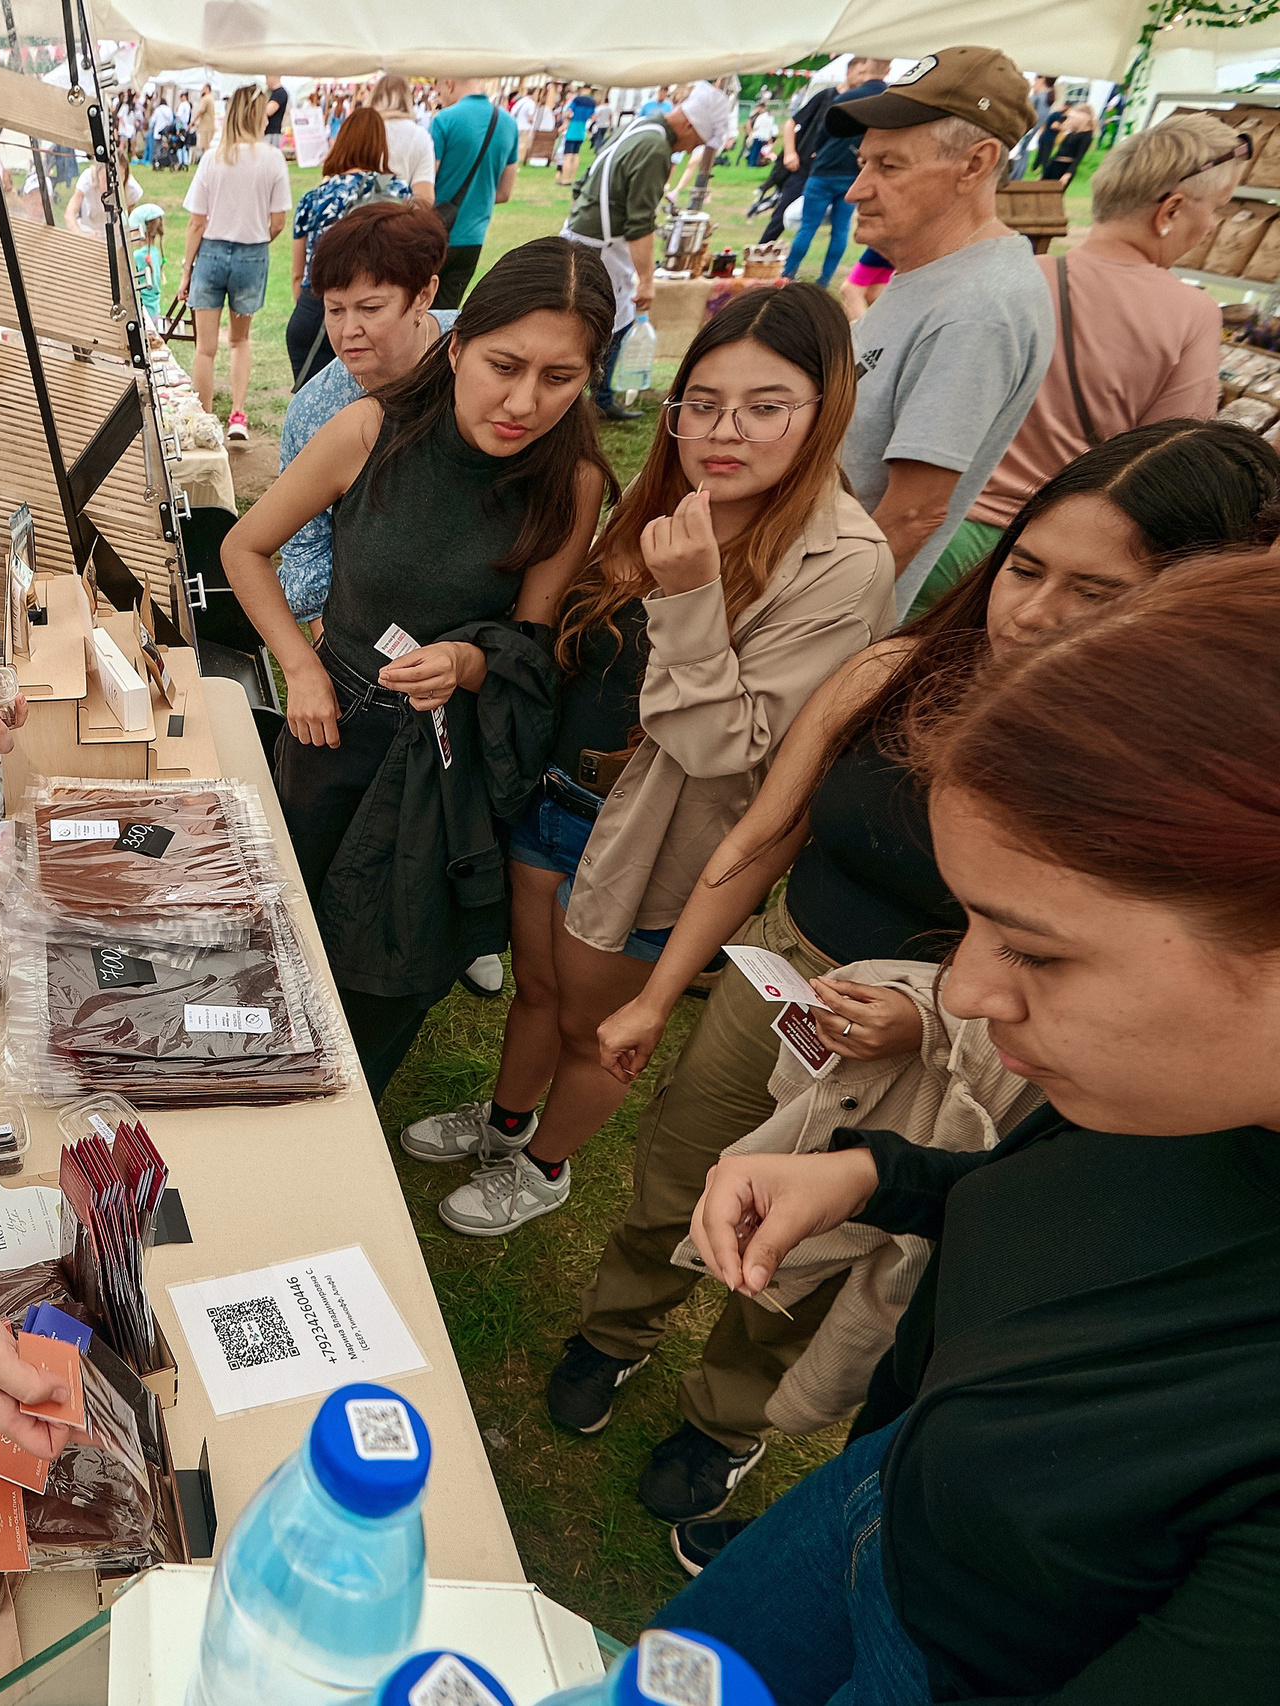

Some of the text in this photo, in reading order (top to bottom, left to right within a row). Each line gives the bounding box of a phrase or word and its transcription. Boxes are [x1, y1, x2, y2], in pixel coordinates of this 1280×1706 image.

[286, 1276, 338, 1364] +79234260446
[310, 1275, 342, 1329] Владимировна
[323, 1274, 371, 1352] (СБЕР, Тинькофф, Альфа)
[338, 1329, 358, 1360] Марина
